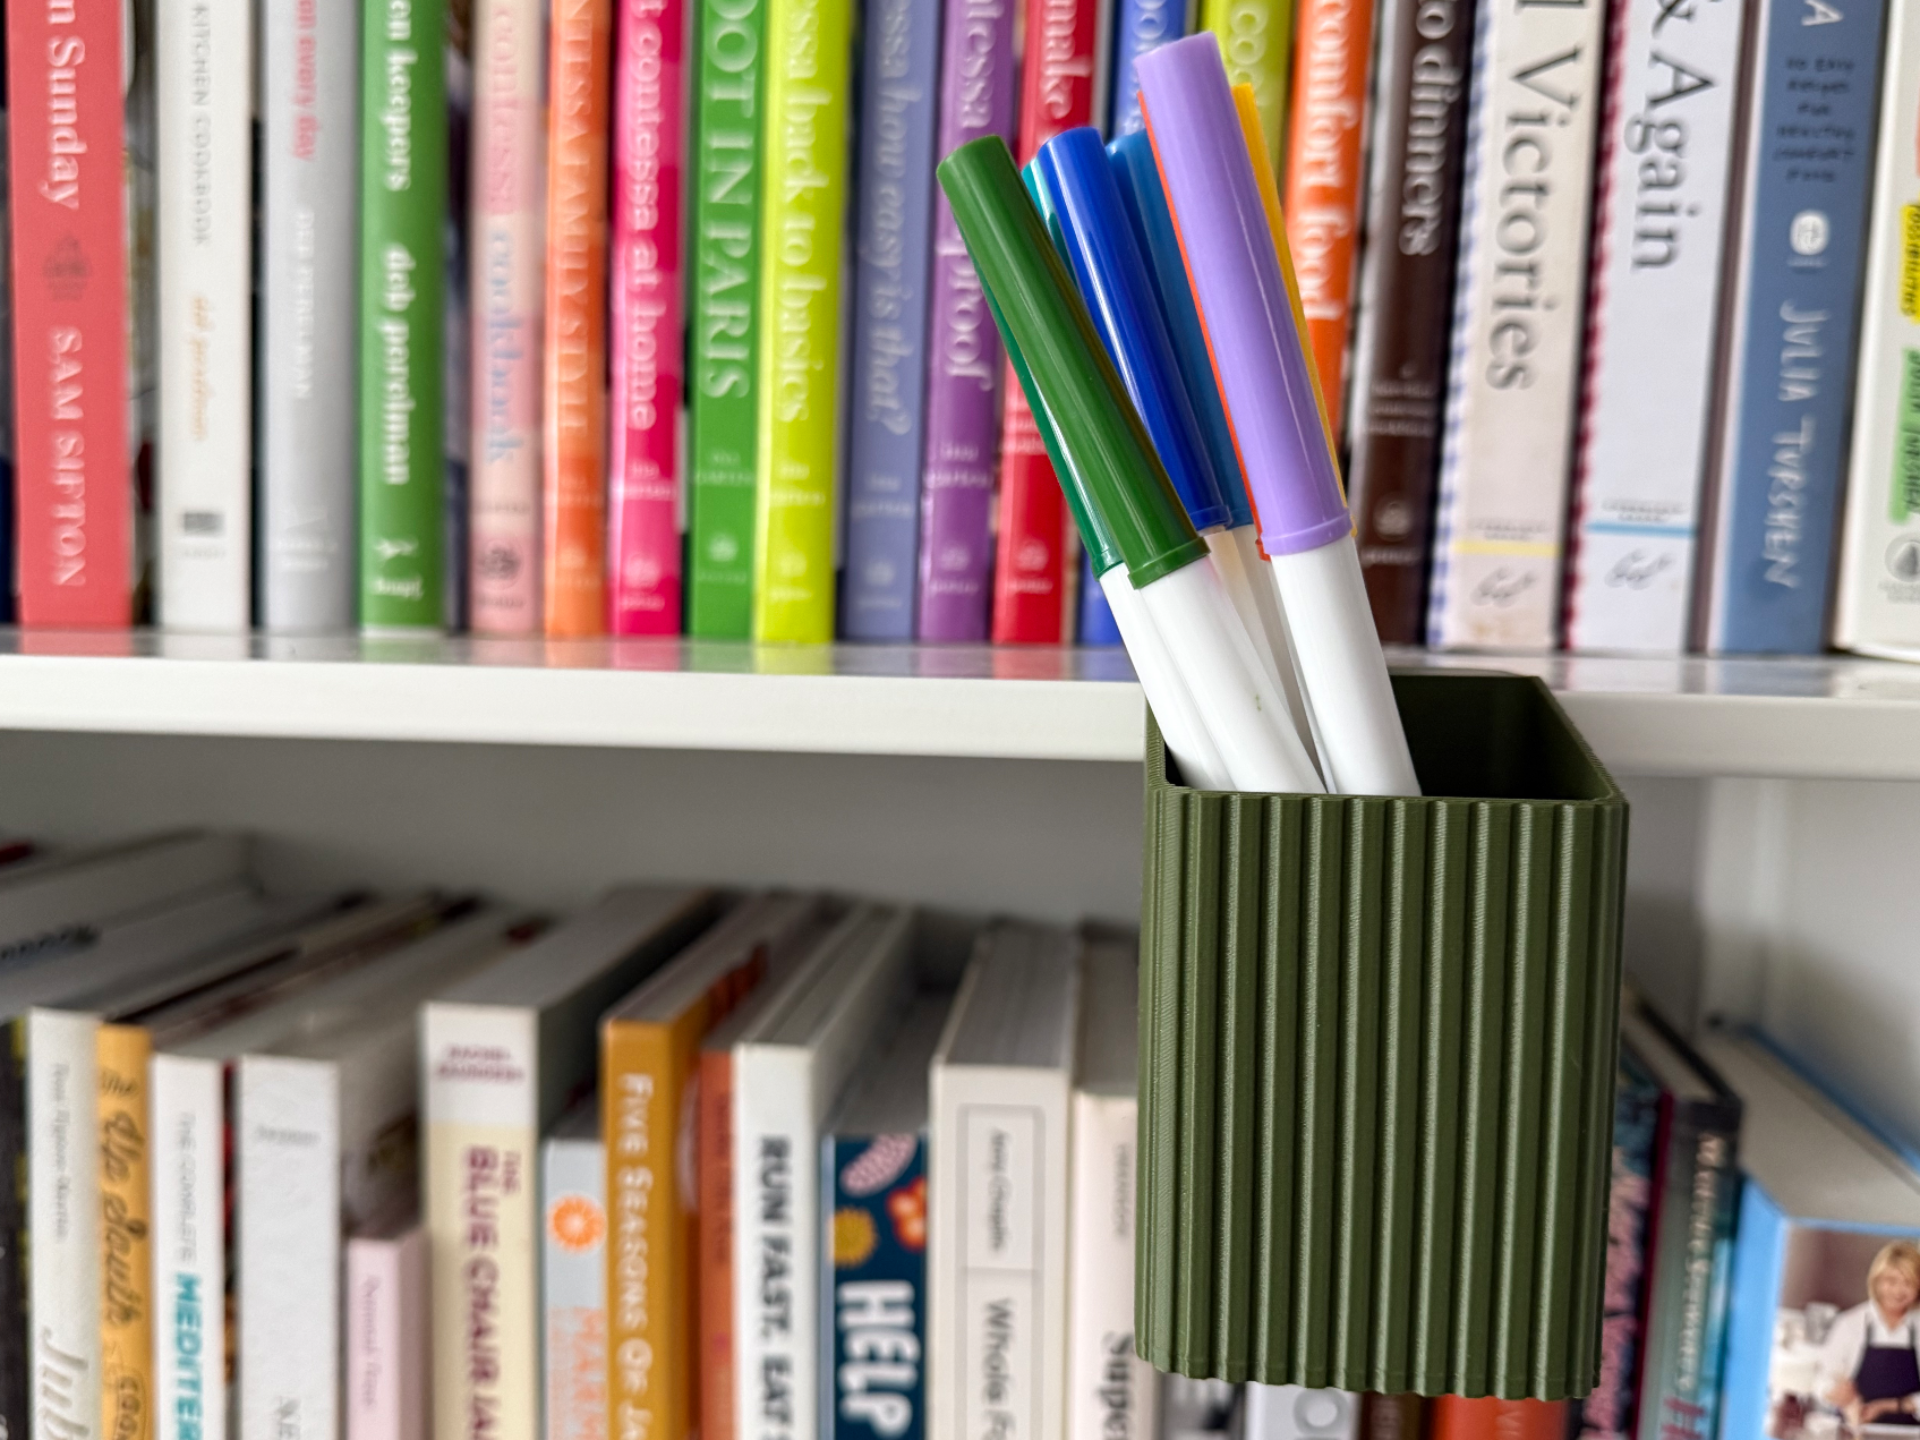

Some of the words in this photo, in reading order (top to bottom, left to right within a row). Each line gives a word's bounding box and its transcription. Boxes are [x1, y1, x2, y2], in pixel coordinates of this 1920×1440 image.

[783, 0, 820, 79] ssa
[37, 35, 88, 210] Sunday
[289, 113, 323, 161] day
[378, 49, 419, 192] keepers
[629, 22, 664, 231] contessa
[706, 132, 756, 206] IN
[782, 89, 833, 205] back
[876, 85, 923, 172] how
[1399, 43, 1462, 256] dinners
[1622, 48, 1719, 273] Again
[189, 117, 213, 248] COOKBOOK
[860, 182, 908, 271] easy
[1484, 45, 1587, 392] Victories
[382, 245, 416, 310] deb
[628, 241, 663, 291] at
[779, 213, 817, 268] to
[1295, 206, 1353, 320] food
[699, 222, 754, 400] PARIS
[777, 275, 827, 424] basics
[868, 283, 914, 320] is
[1778, 301, 1831, 403] JULIA
[47, 325, 84, 421] SAM
[373, 316, 416, 485] perelman
[626, 298, 667, 431] home
[865, 323, 915, 436] that?
[49, 430, 87, 587] SIFTON
[1762, 415, 1815, 590] TURSHEN
[616, 1072, 656, 1157] FIVE
[465, 1145, 502, 1249] BLUE
[757, 1133, 795, 1226] RUN
[616, 1166, 656, 1332] SEASONS
[758, 1234, 795, 1345] FAST.
[465, 1256, 502, 1385] CHAIR
[615, 1338, 656, 1396] OF
[836, 1280, 922, 1437] HELP
[981, 1296, 1020, 1406] Whole
[759, 1354, 795, 1426] EAT
